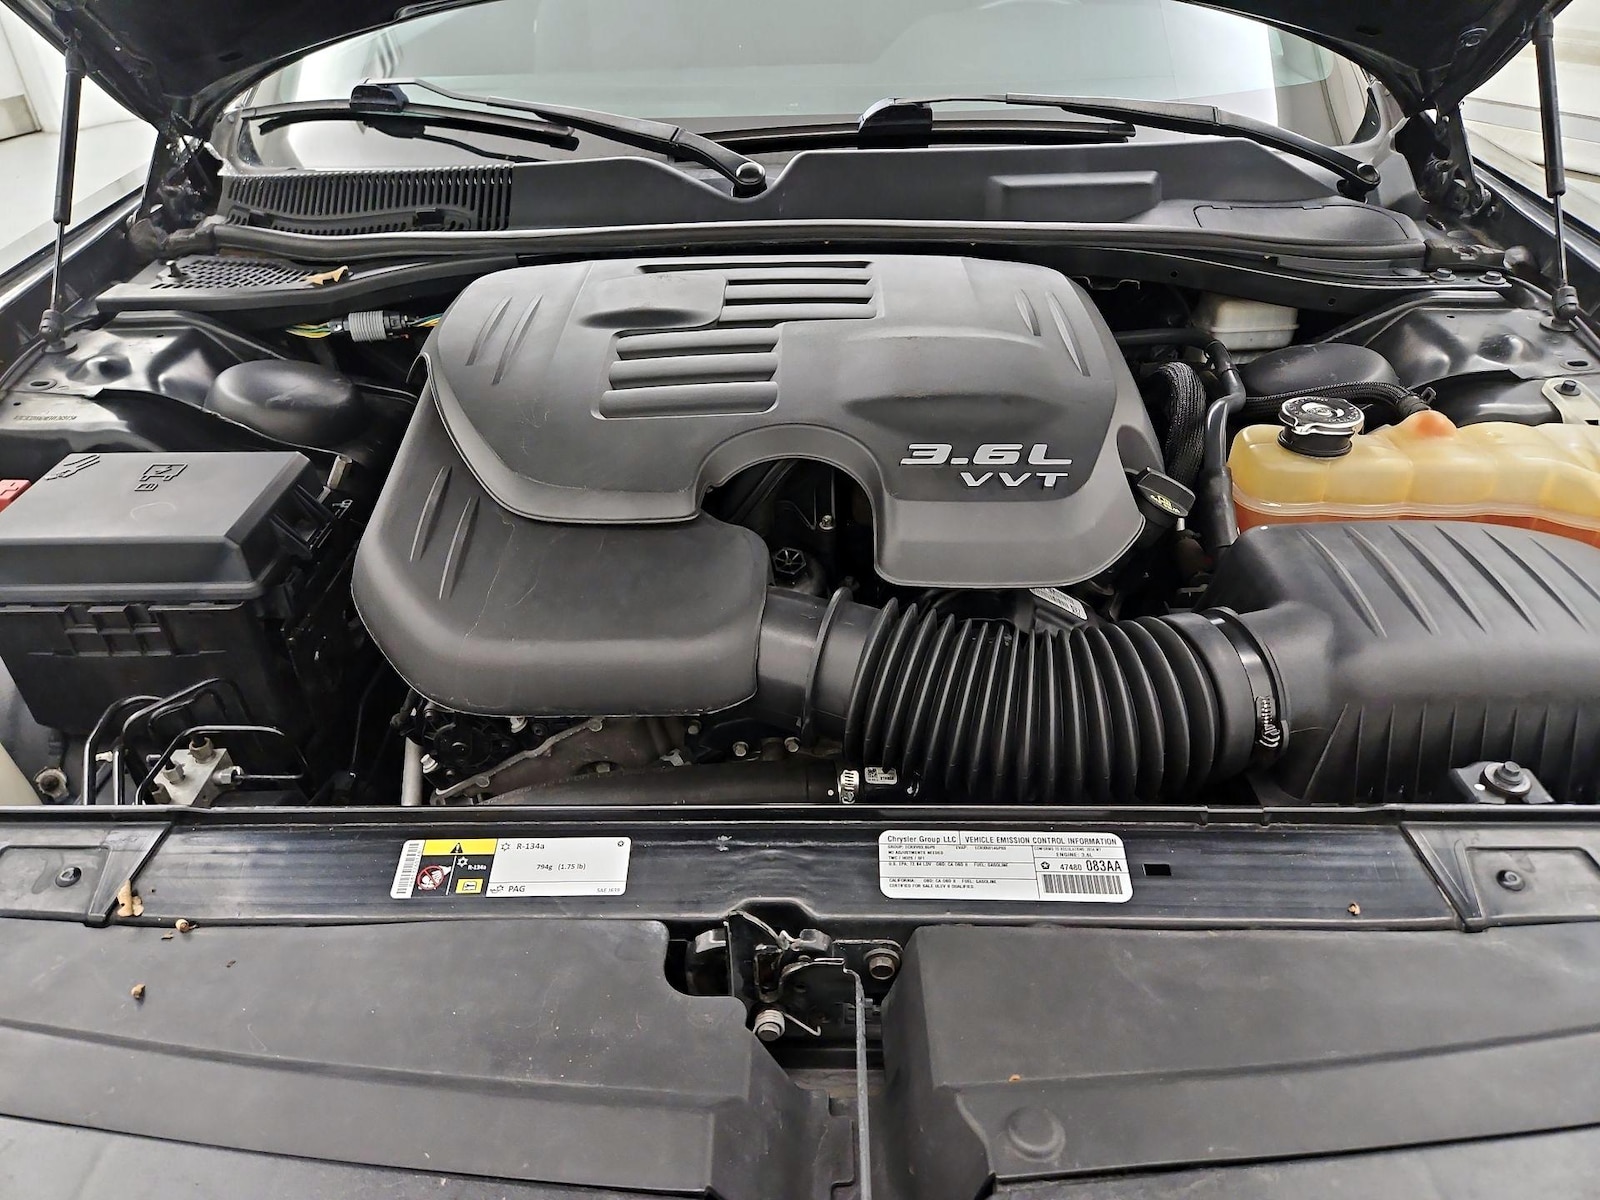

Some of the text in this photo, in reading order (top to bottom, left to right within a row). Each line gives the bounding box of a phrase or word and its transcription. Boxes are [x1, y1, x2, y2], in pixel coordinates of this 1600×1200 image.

[900, 443, 1073, 465] 3.6L
[960, 471, 1069, 487] VVT
[887, 835, 957, 844] Chrysler Group LLC
[996, 836, 1030, 844] EMISSION
[1068, 837, 1117, 845] INFORMATION
[557, 863, 575, 871] (1.75
[576, 863, 586, 871] lb)
[1060, 860, 1122, 872] 47480 083AA
[508, 885, 526, 893] PAG
